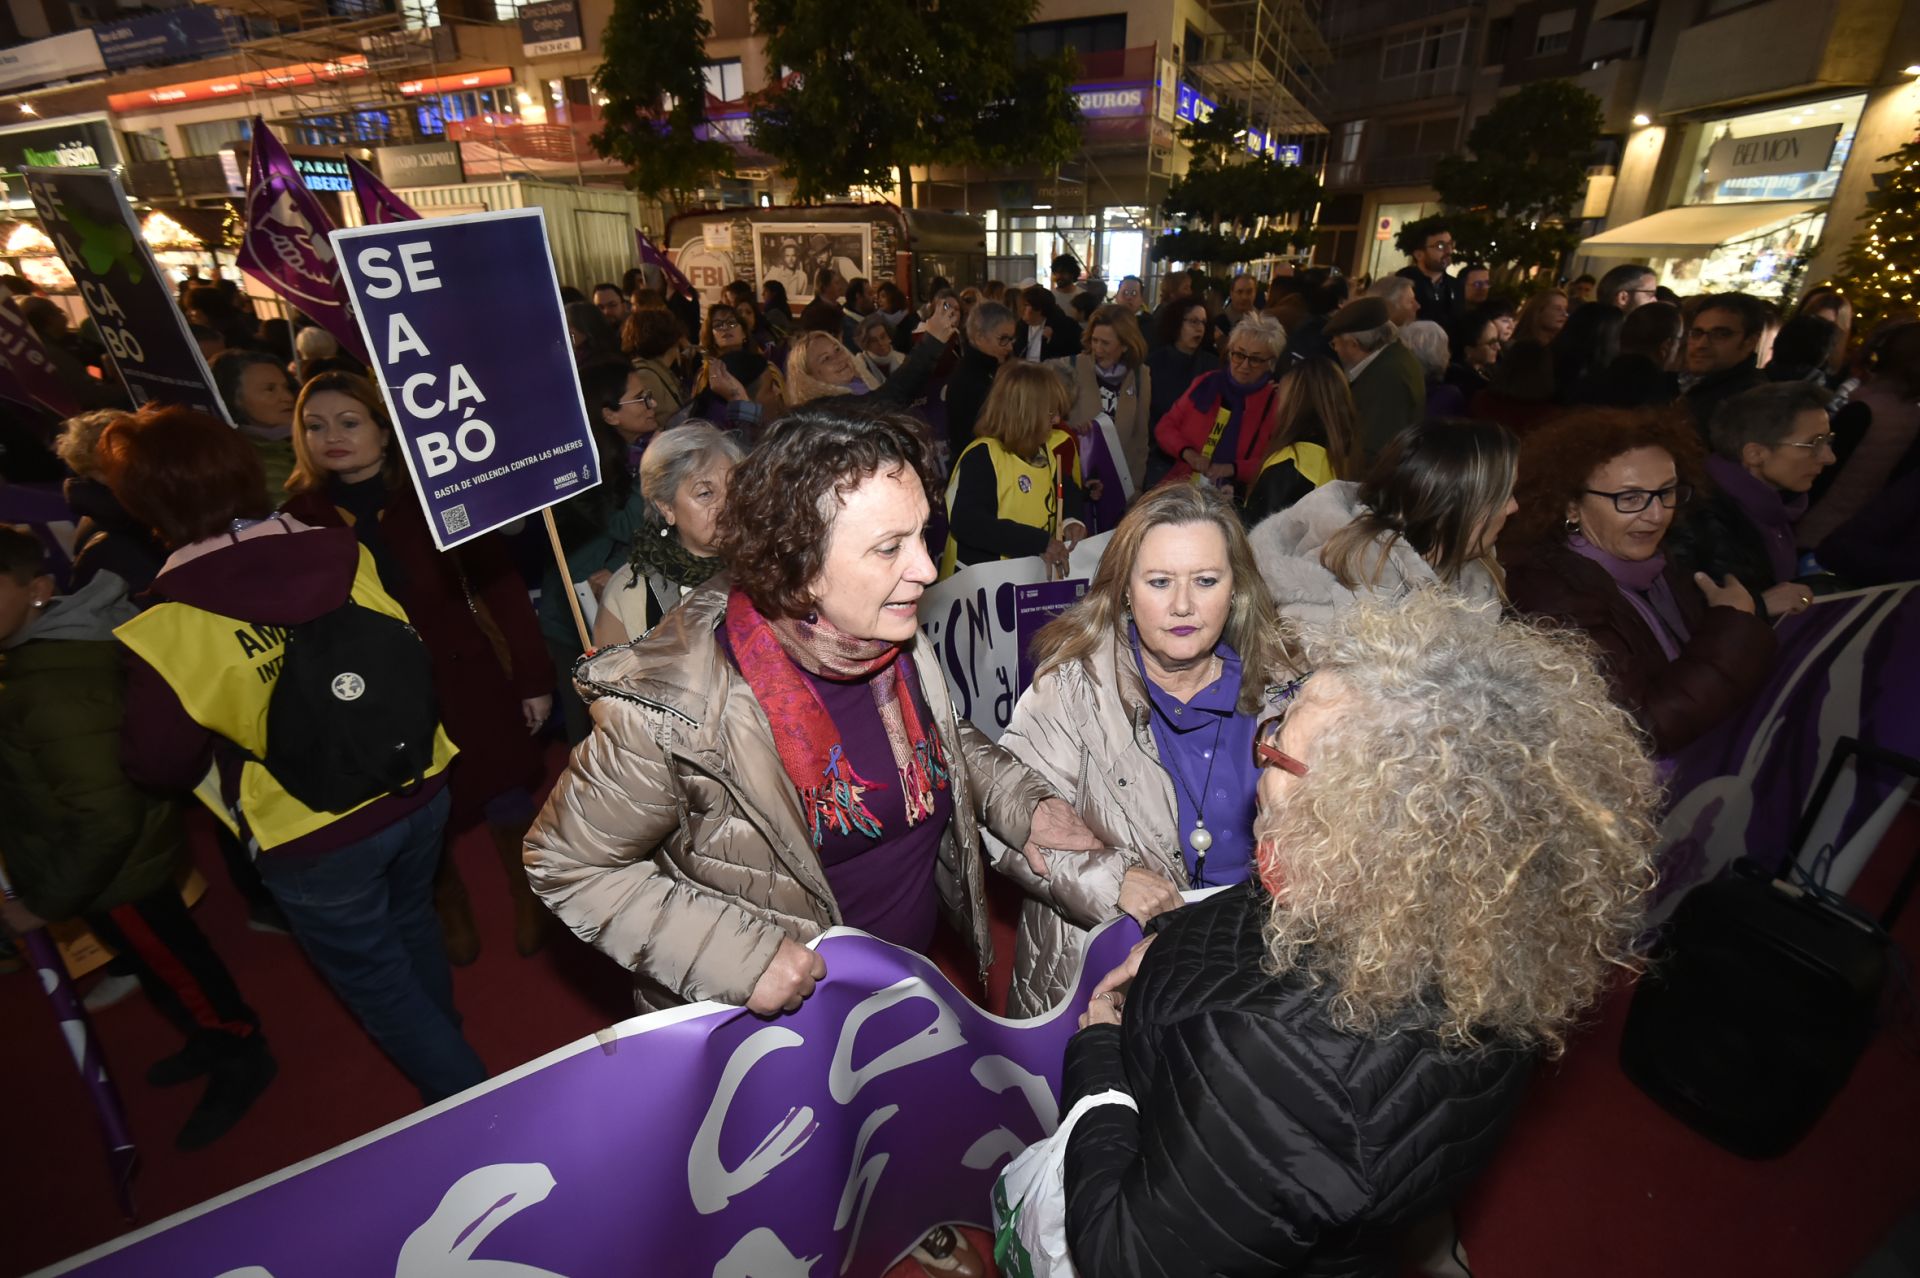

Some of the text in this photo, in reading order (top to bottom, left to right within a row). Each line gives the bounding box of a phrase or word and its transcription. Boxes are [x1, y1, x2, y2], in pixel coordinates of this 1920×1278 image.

[357, 241, 442, 299] SE
[690, 266, 723, 286] FBI
[81, 280, 127, 320] CA
[388, 312, 430, 364] A
[402, 363, 486, 419] CA
[416, 407, 496, 478] BÓ
[434, 439, 584, 500] BASTA DE VIOLENCIA CONTRA LAS MUJERES
